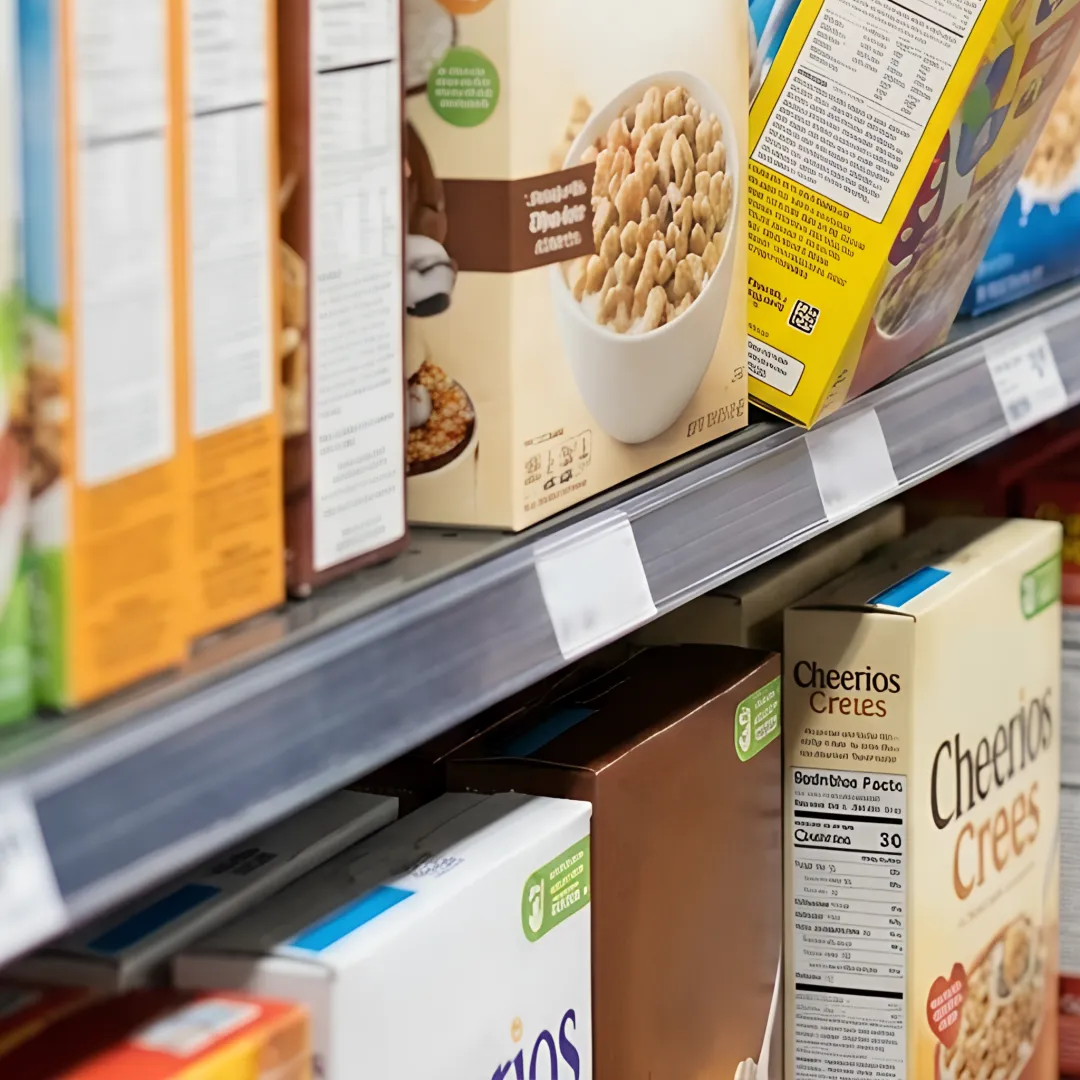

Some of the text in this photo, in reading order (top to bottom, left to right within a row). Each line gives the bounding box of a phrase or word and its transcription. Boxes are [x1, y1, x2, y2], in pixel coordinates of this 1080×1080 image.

[793, 660, 901, 693] Cheerios
[930, 686, 1054, 830] Cheerios
[880, 832, 902, 849] 30
[952, 780, 1041, 901] Crees
